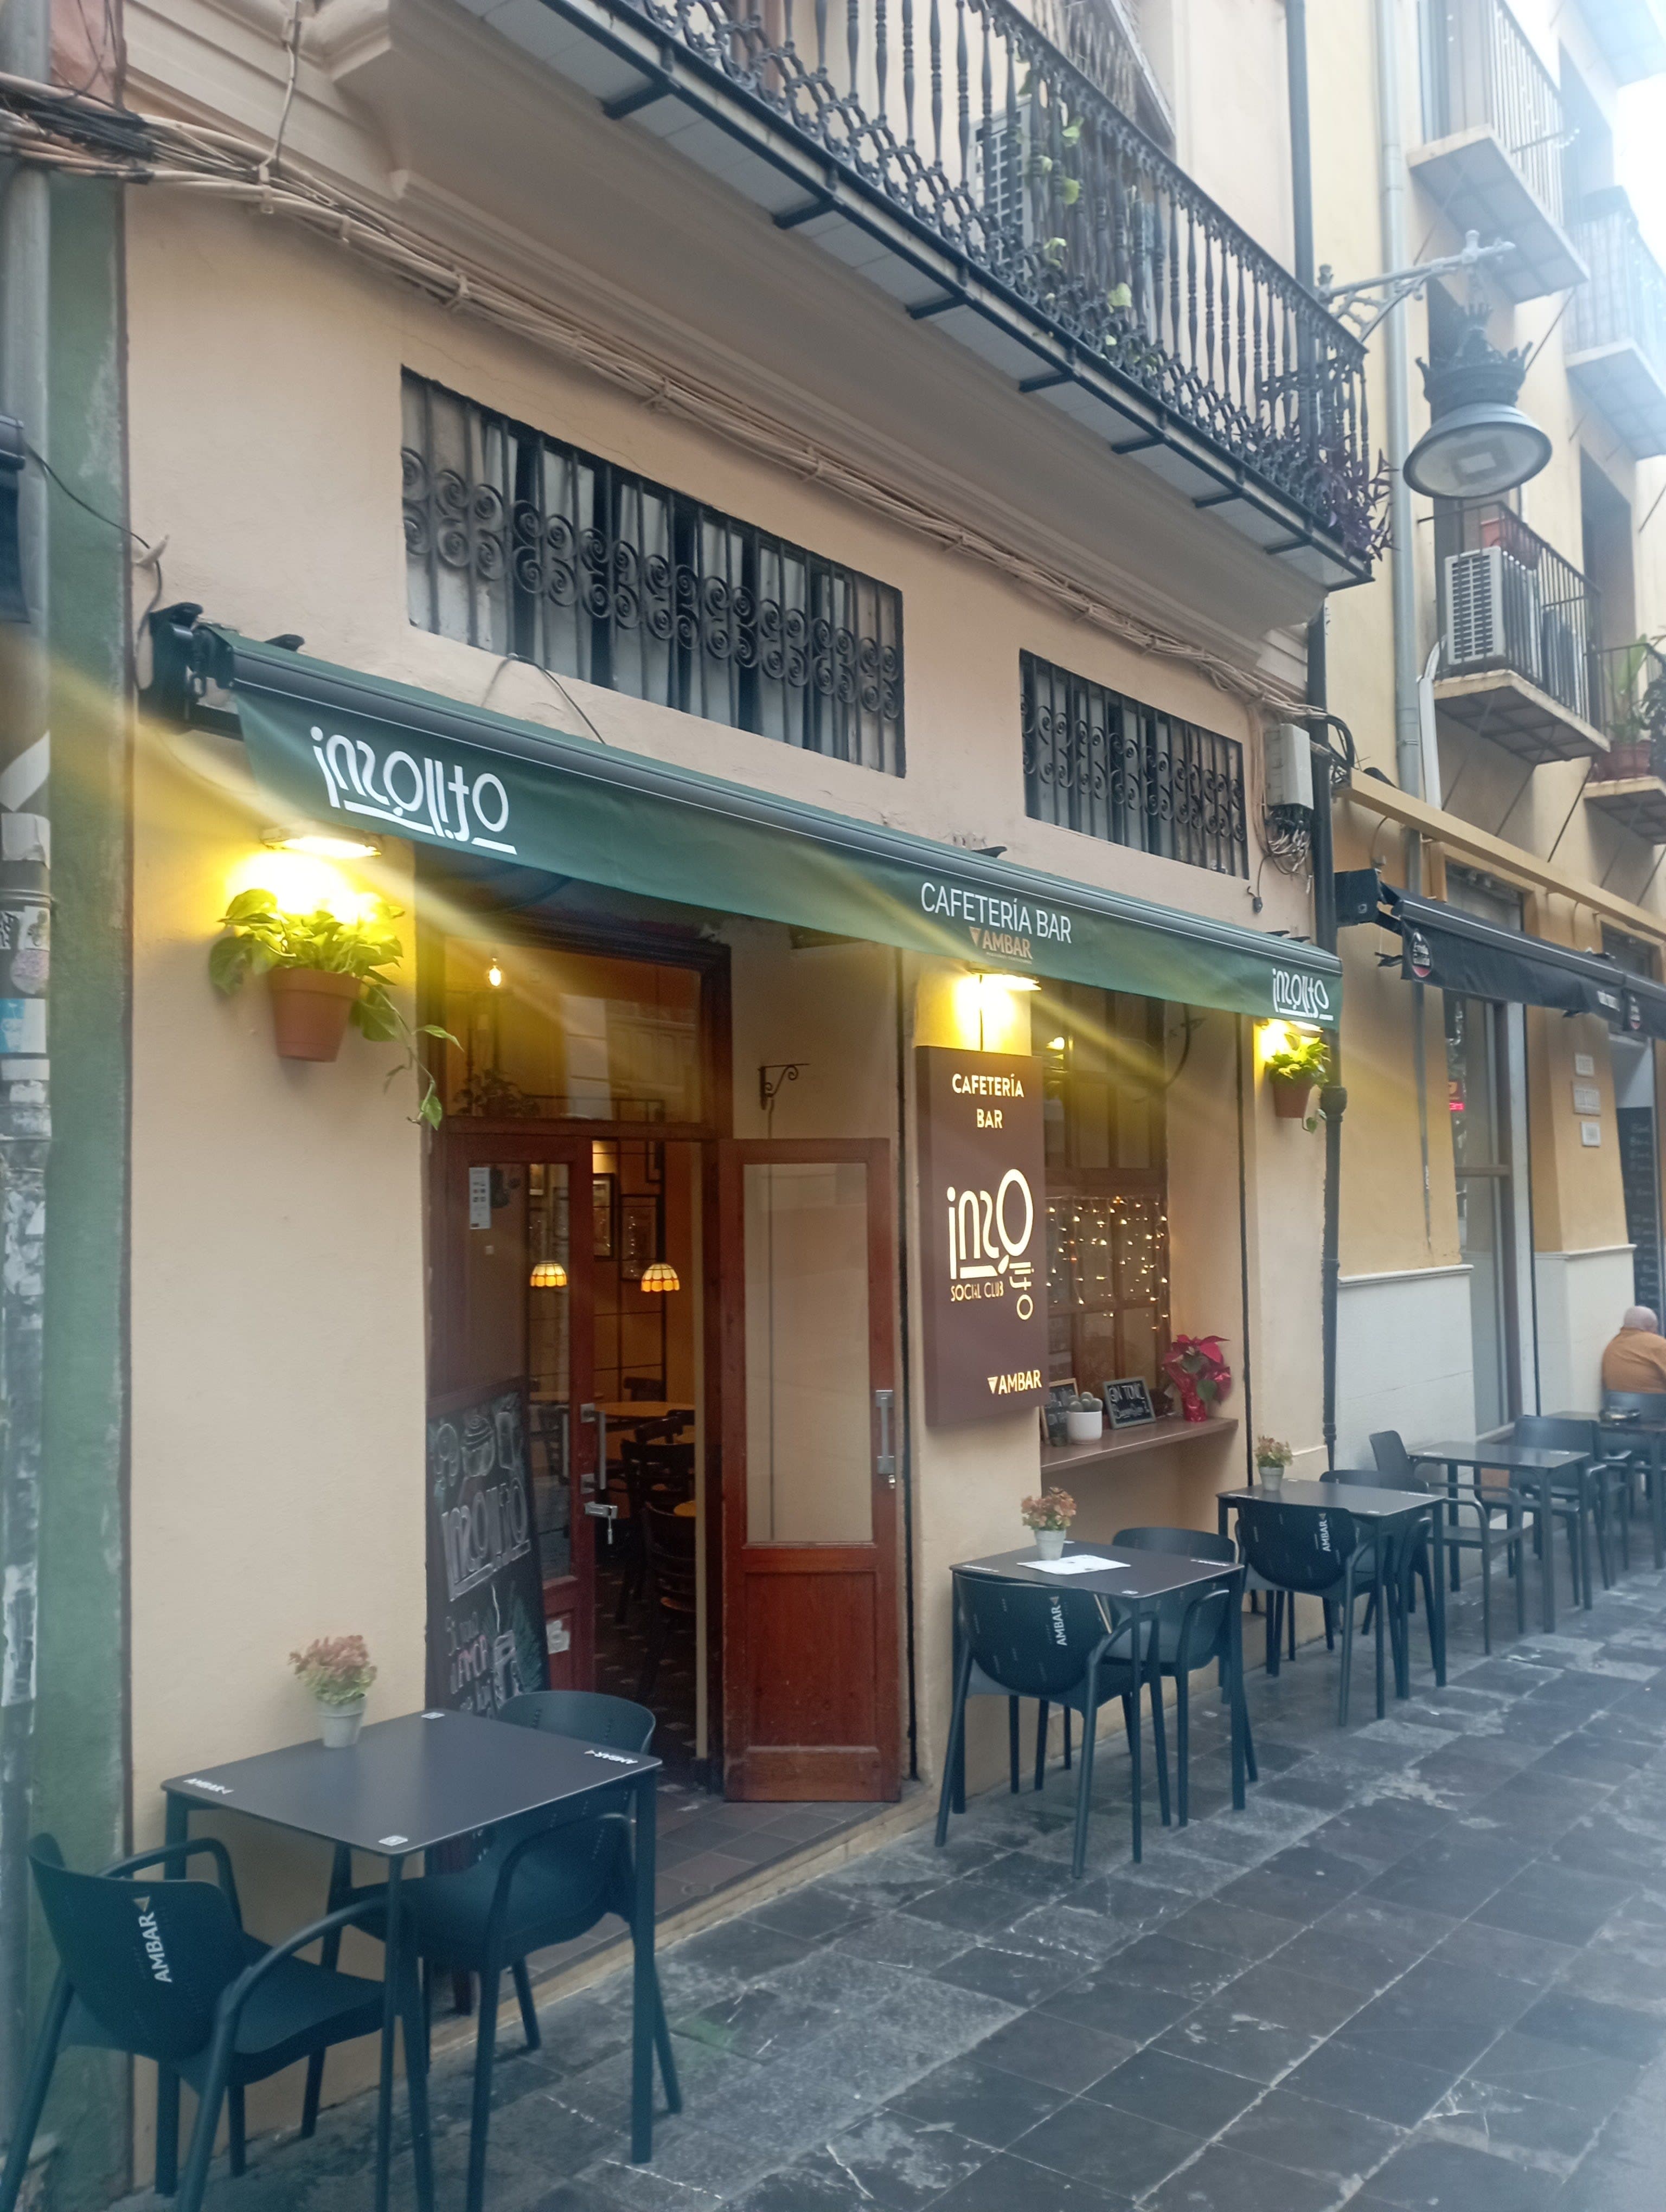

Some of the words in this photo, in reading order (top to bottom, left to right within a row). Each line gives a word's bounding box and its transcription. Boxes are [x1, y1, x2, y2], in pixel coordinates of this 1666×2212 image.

[921, 882, 1032, 934] CAFETERÍA
[1036, 909, 1072, 943] BAR
[983, 929, 1033, 959] AMBAR
[952, 1073, 1024, 1098] CAFETERÍA
[977, 1108, 1003, 1129] BAR
[951, 1283, 982, 1301] SOCIAL
[984, 1281, 1004, 1298] CLUB
[998, 1369, 1042, 1394] AMBAR
[1319, 1520, 1331, 1552] AMBAR
[1051, 1605, 1067, 1645] AMBAR
[138, 1912, 173, 1983] AMBAR
